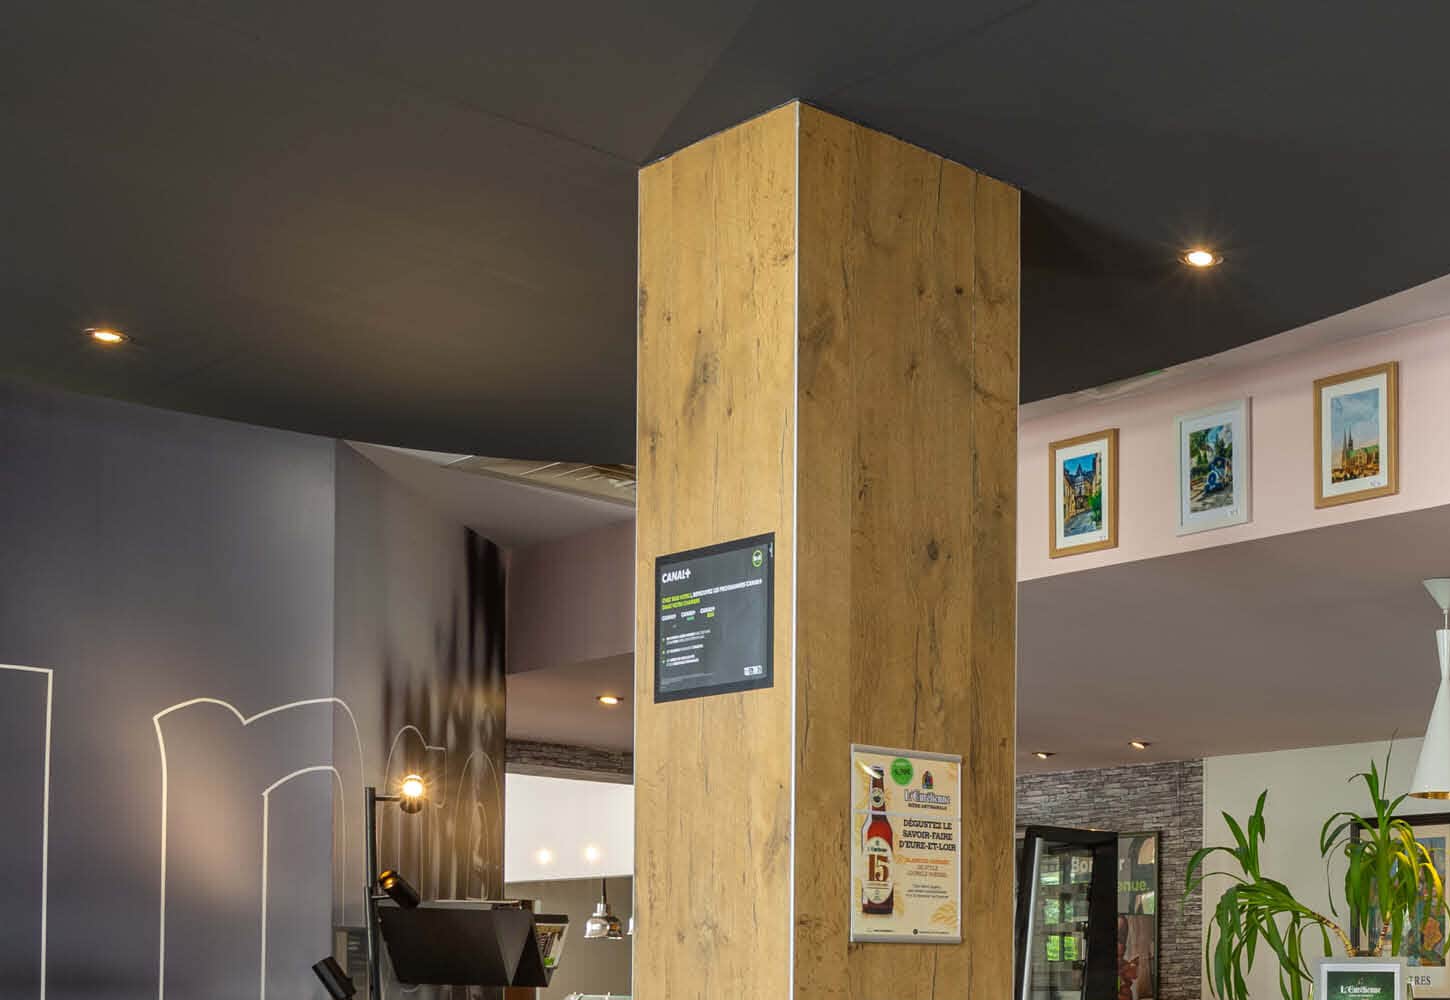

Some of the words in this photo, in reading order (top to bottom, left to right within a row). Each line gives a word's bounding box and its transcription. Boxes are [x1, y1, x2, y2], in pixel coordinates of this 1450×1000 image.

[662, 568, 691, 583] CANAL+
[904, 818, 942, 829] DÉGUSTEZ
[944, 822, 952, 830] LE
[903, 830, 952, 841] SAVOIR-FAIRE
[899, 840, 956, 851] D'EURE-ET-LOIR
[869, 854, 889, 881] 15
